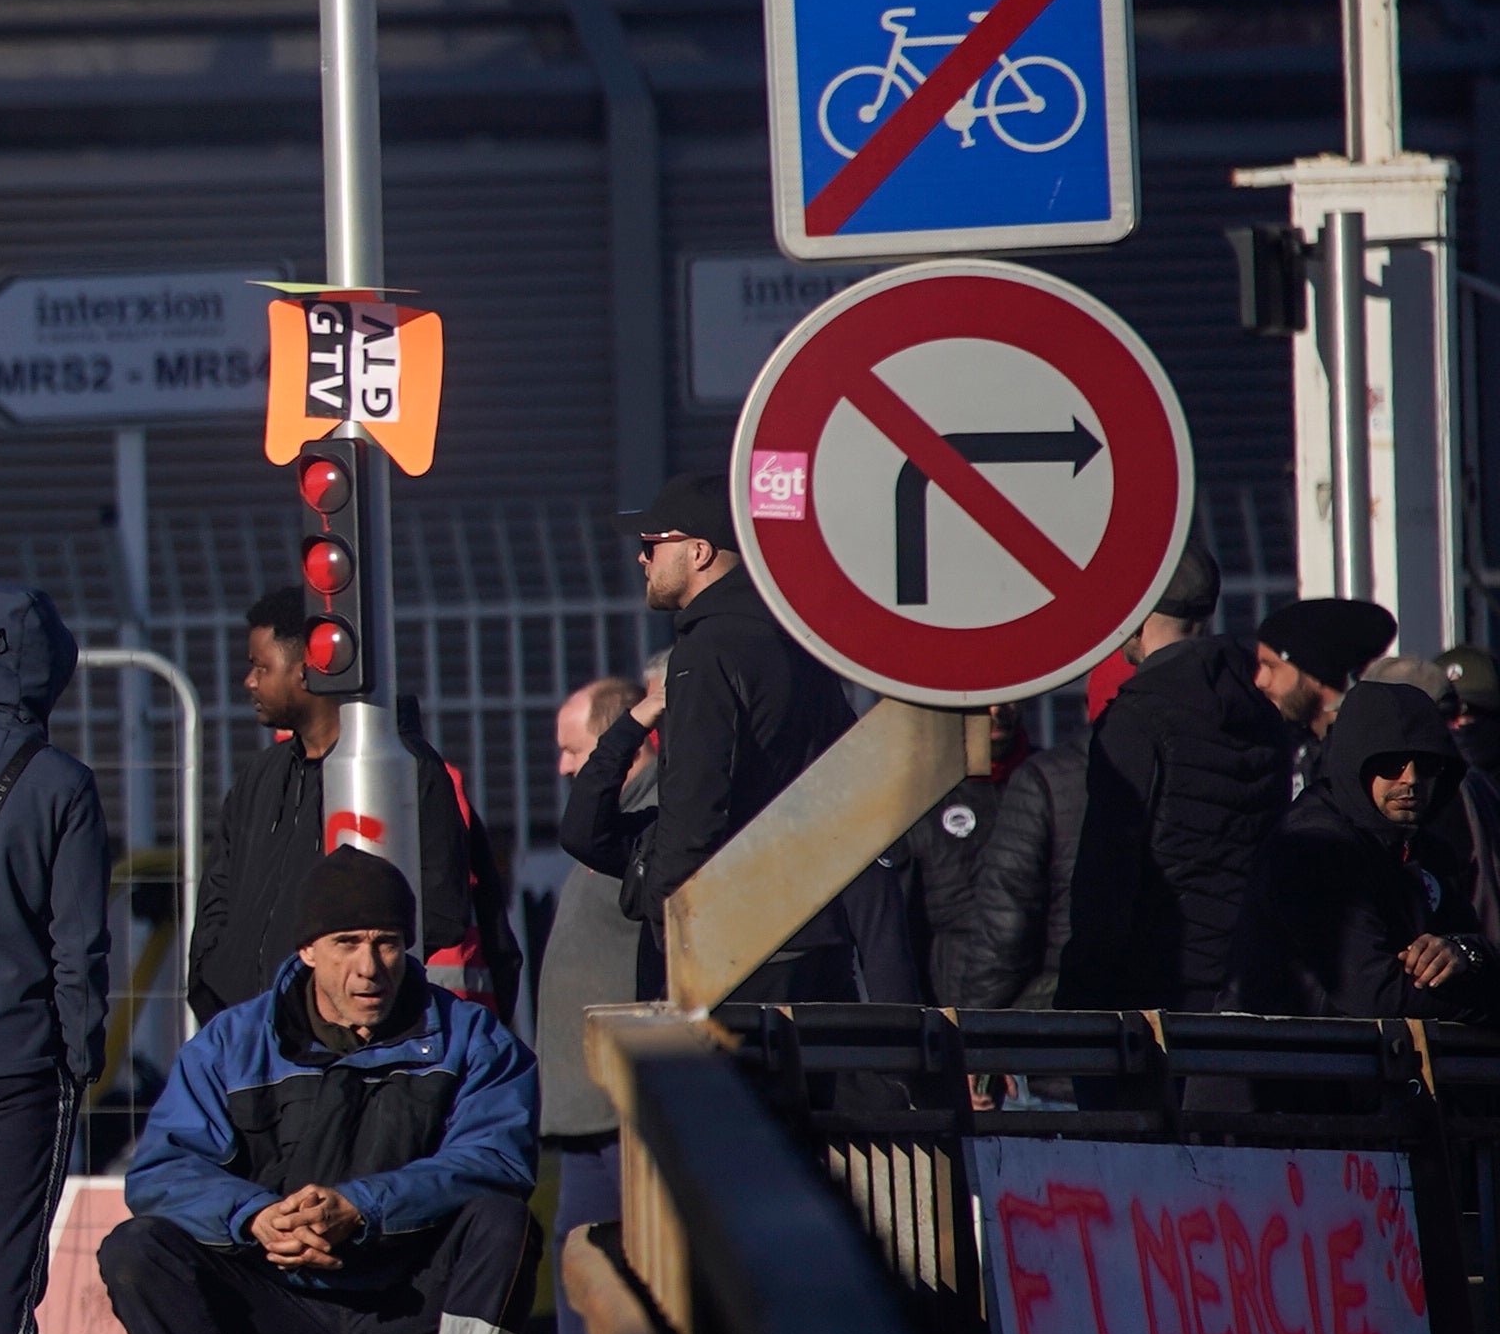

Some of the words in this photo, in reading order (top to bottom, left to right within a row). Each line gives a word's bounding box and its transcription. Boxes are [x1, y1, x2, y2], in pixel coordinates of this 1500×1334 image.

[309, 303, 344, 409] GTV
[362, 314, 396, 418] GTV
[754, 468, 806, 501] cgt
